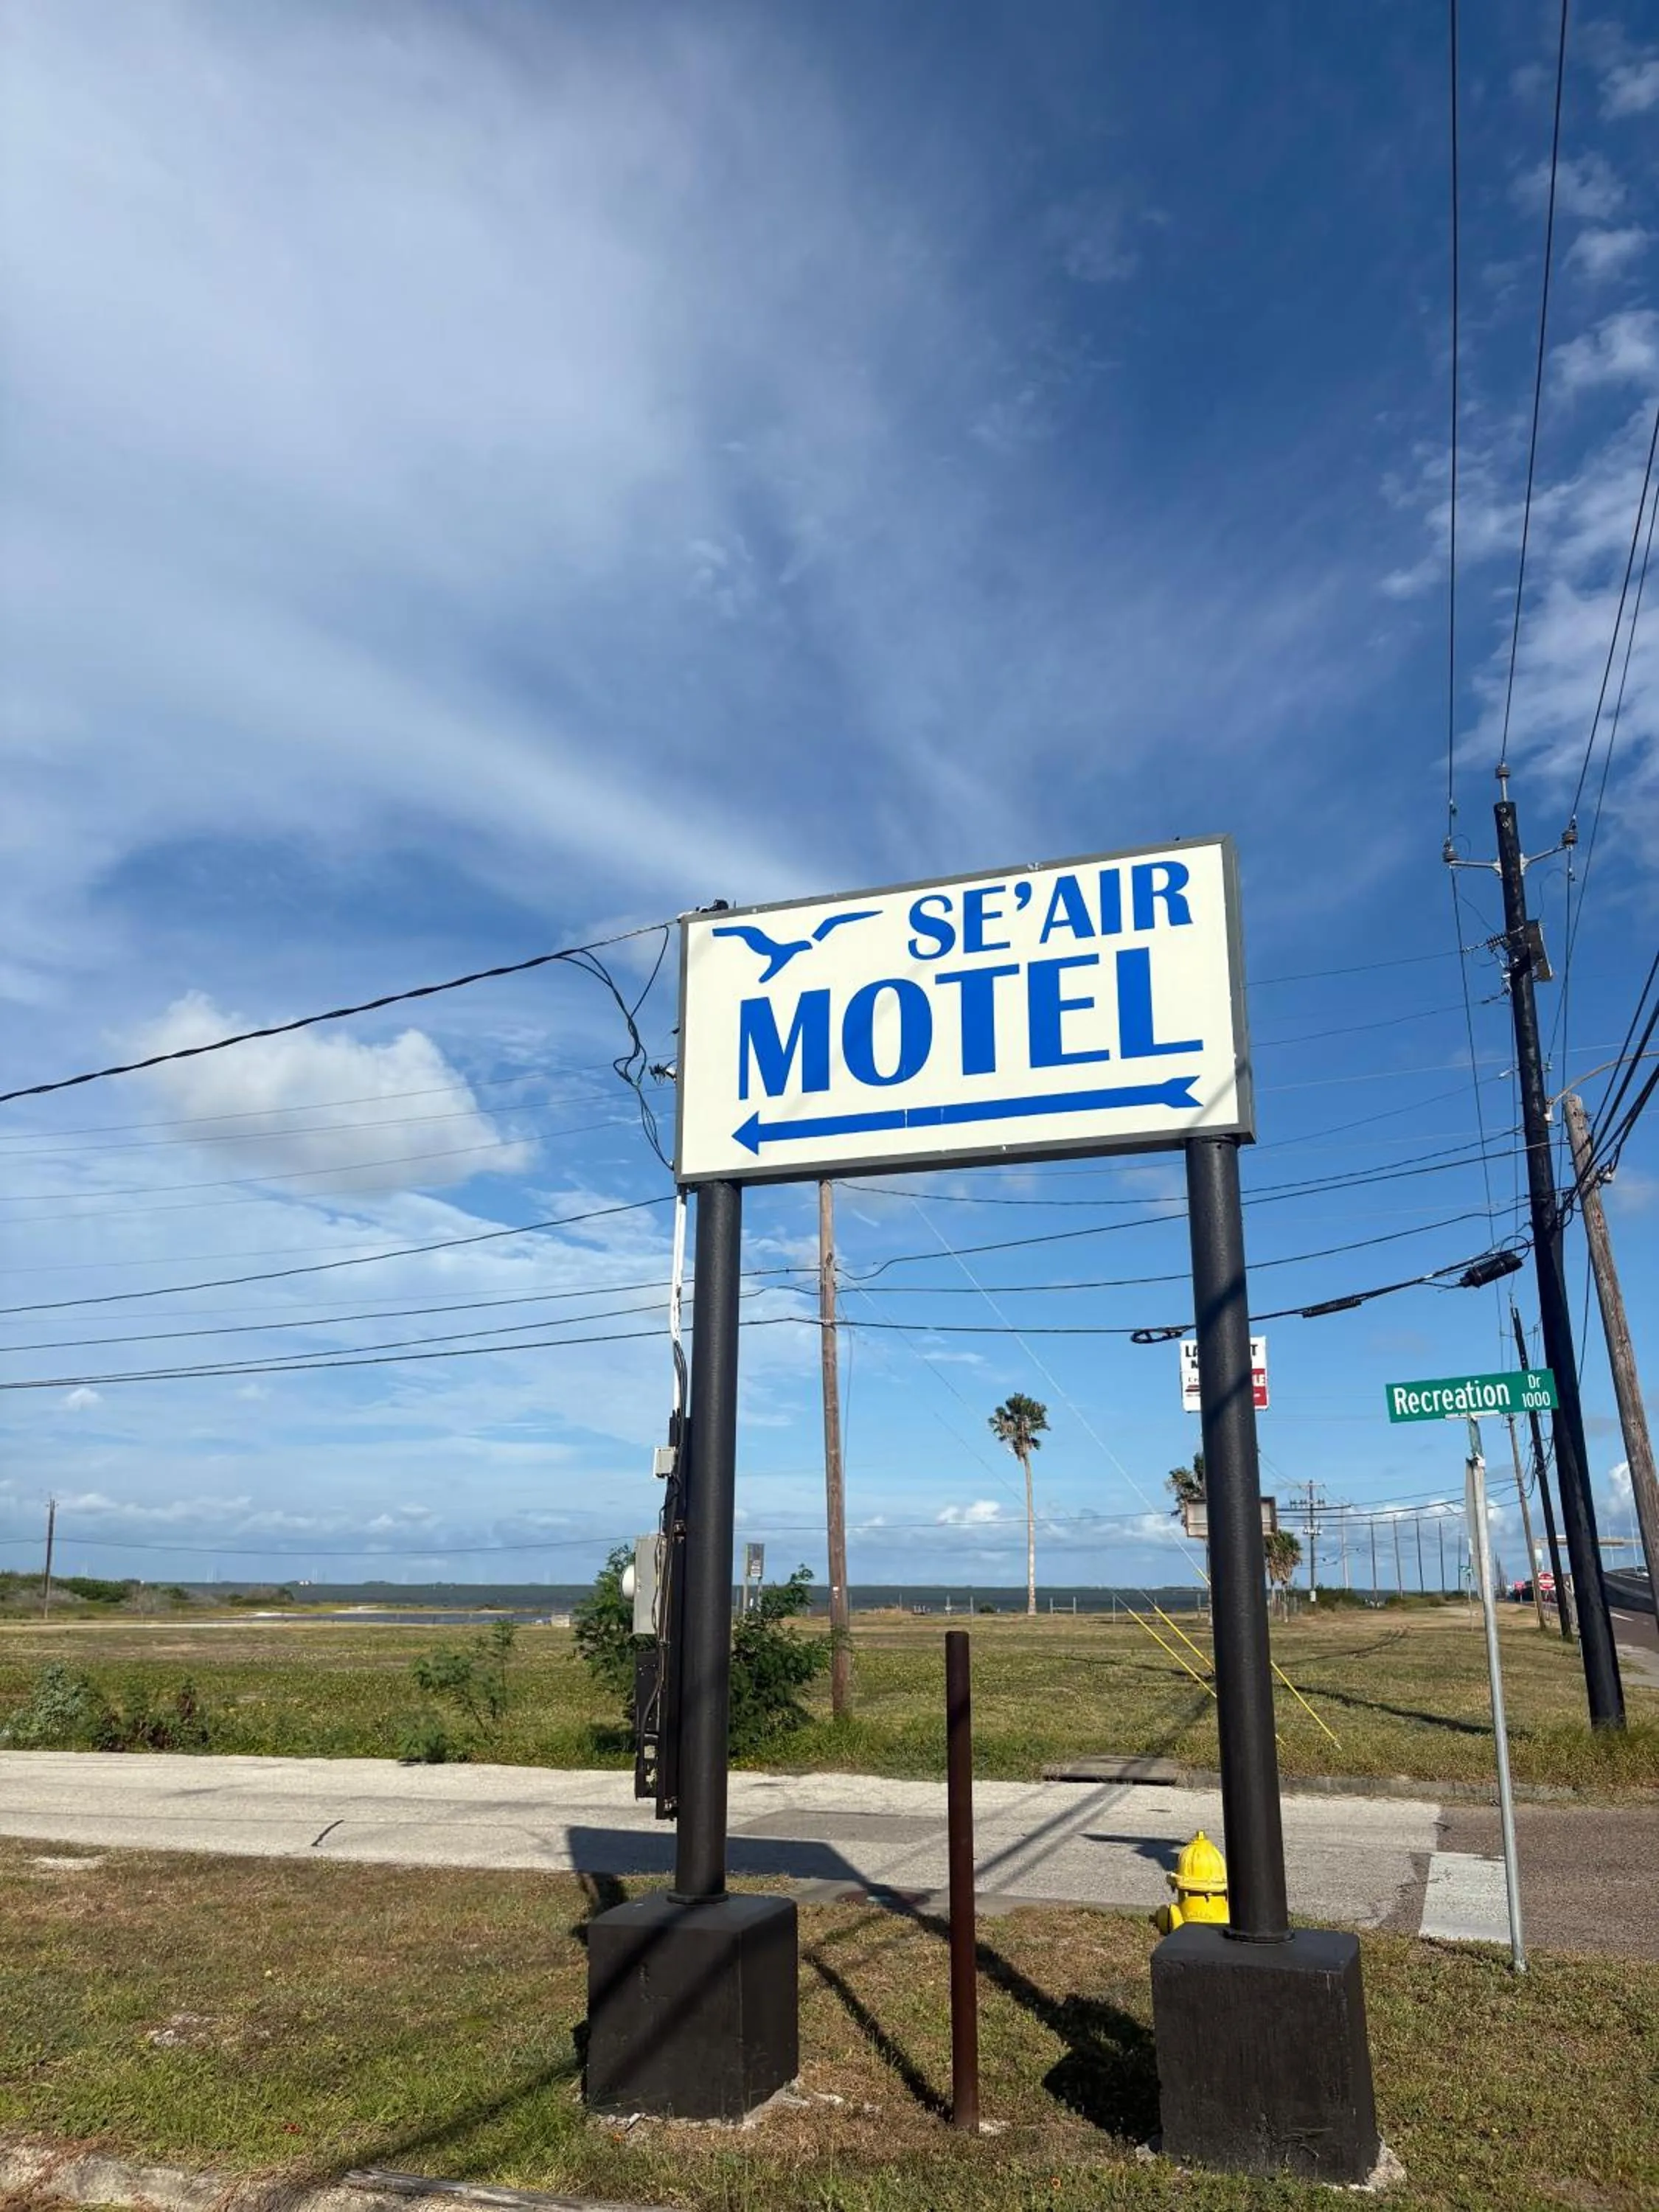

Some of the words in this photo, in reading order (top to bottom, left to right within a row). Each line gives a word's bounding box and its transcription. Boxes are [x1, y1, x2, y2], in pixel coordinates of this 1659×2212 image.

[738, 947, 1204, 1101] MOTEL
[1393, 1380, 1511, 1415] Recreation
[1527, 1374, 1540, 1388] Dr
[1521, 1391, 1551, 1408] 1000
